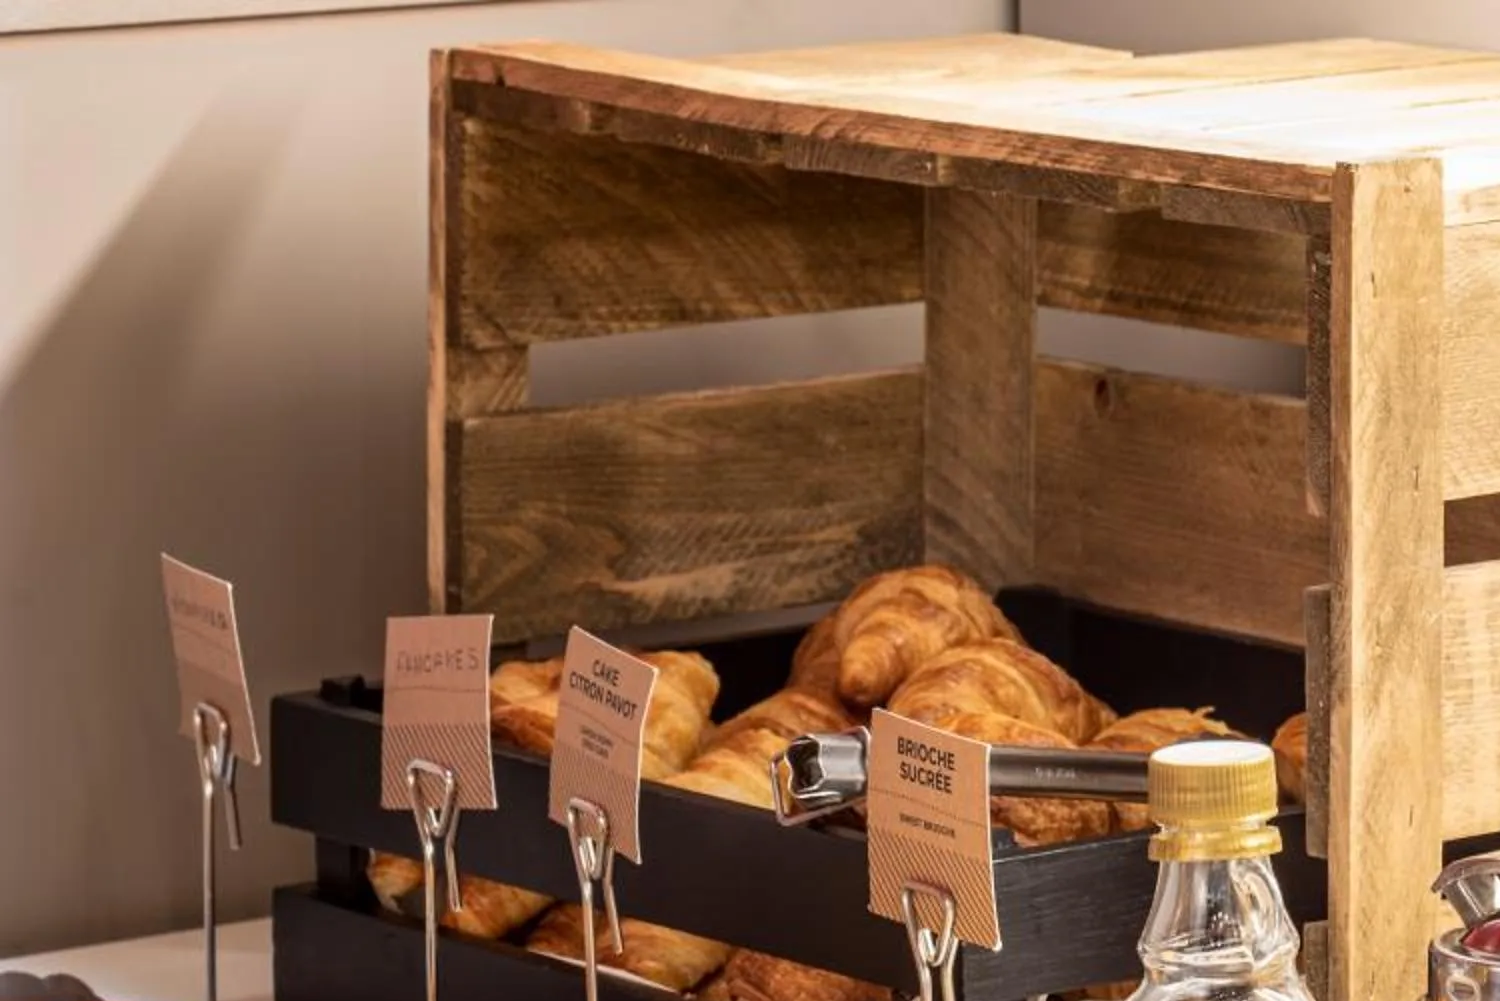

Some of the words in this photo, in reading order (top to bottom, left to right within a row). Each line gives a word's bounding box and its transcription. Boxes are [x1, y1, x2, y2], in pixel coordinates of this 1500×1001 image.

[593, 659, 621, 687] CAKE
[569, 671, 604, 704] CITRON
[605, 690, 638, 720] PAVOT
[897, 736, 956, 771] BRIOCHE
[899, 761, 952, 794] SUCRÉE
